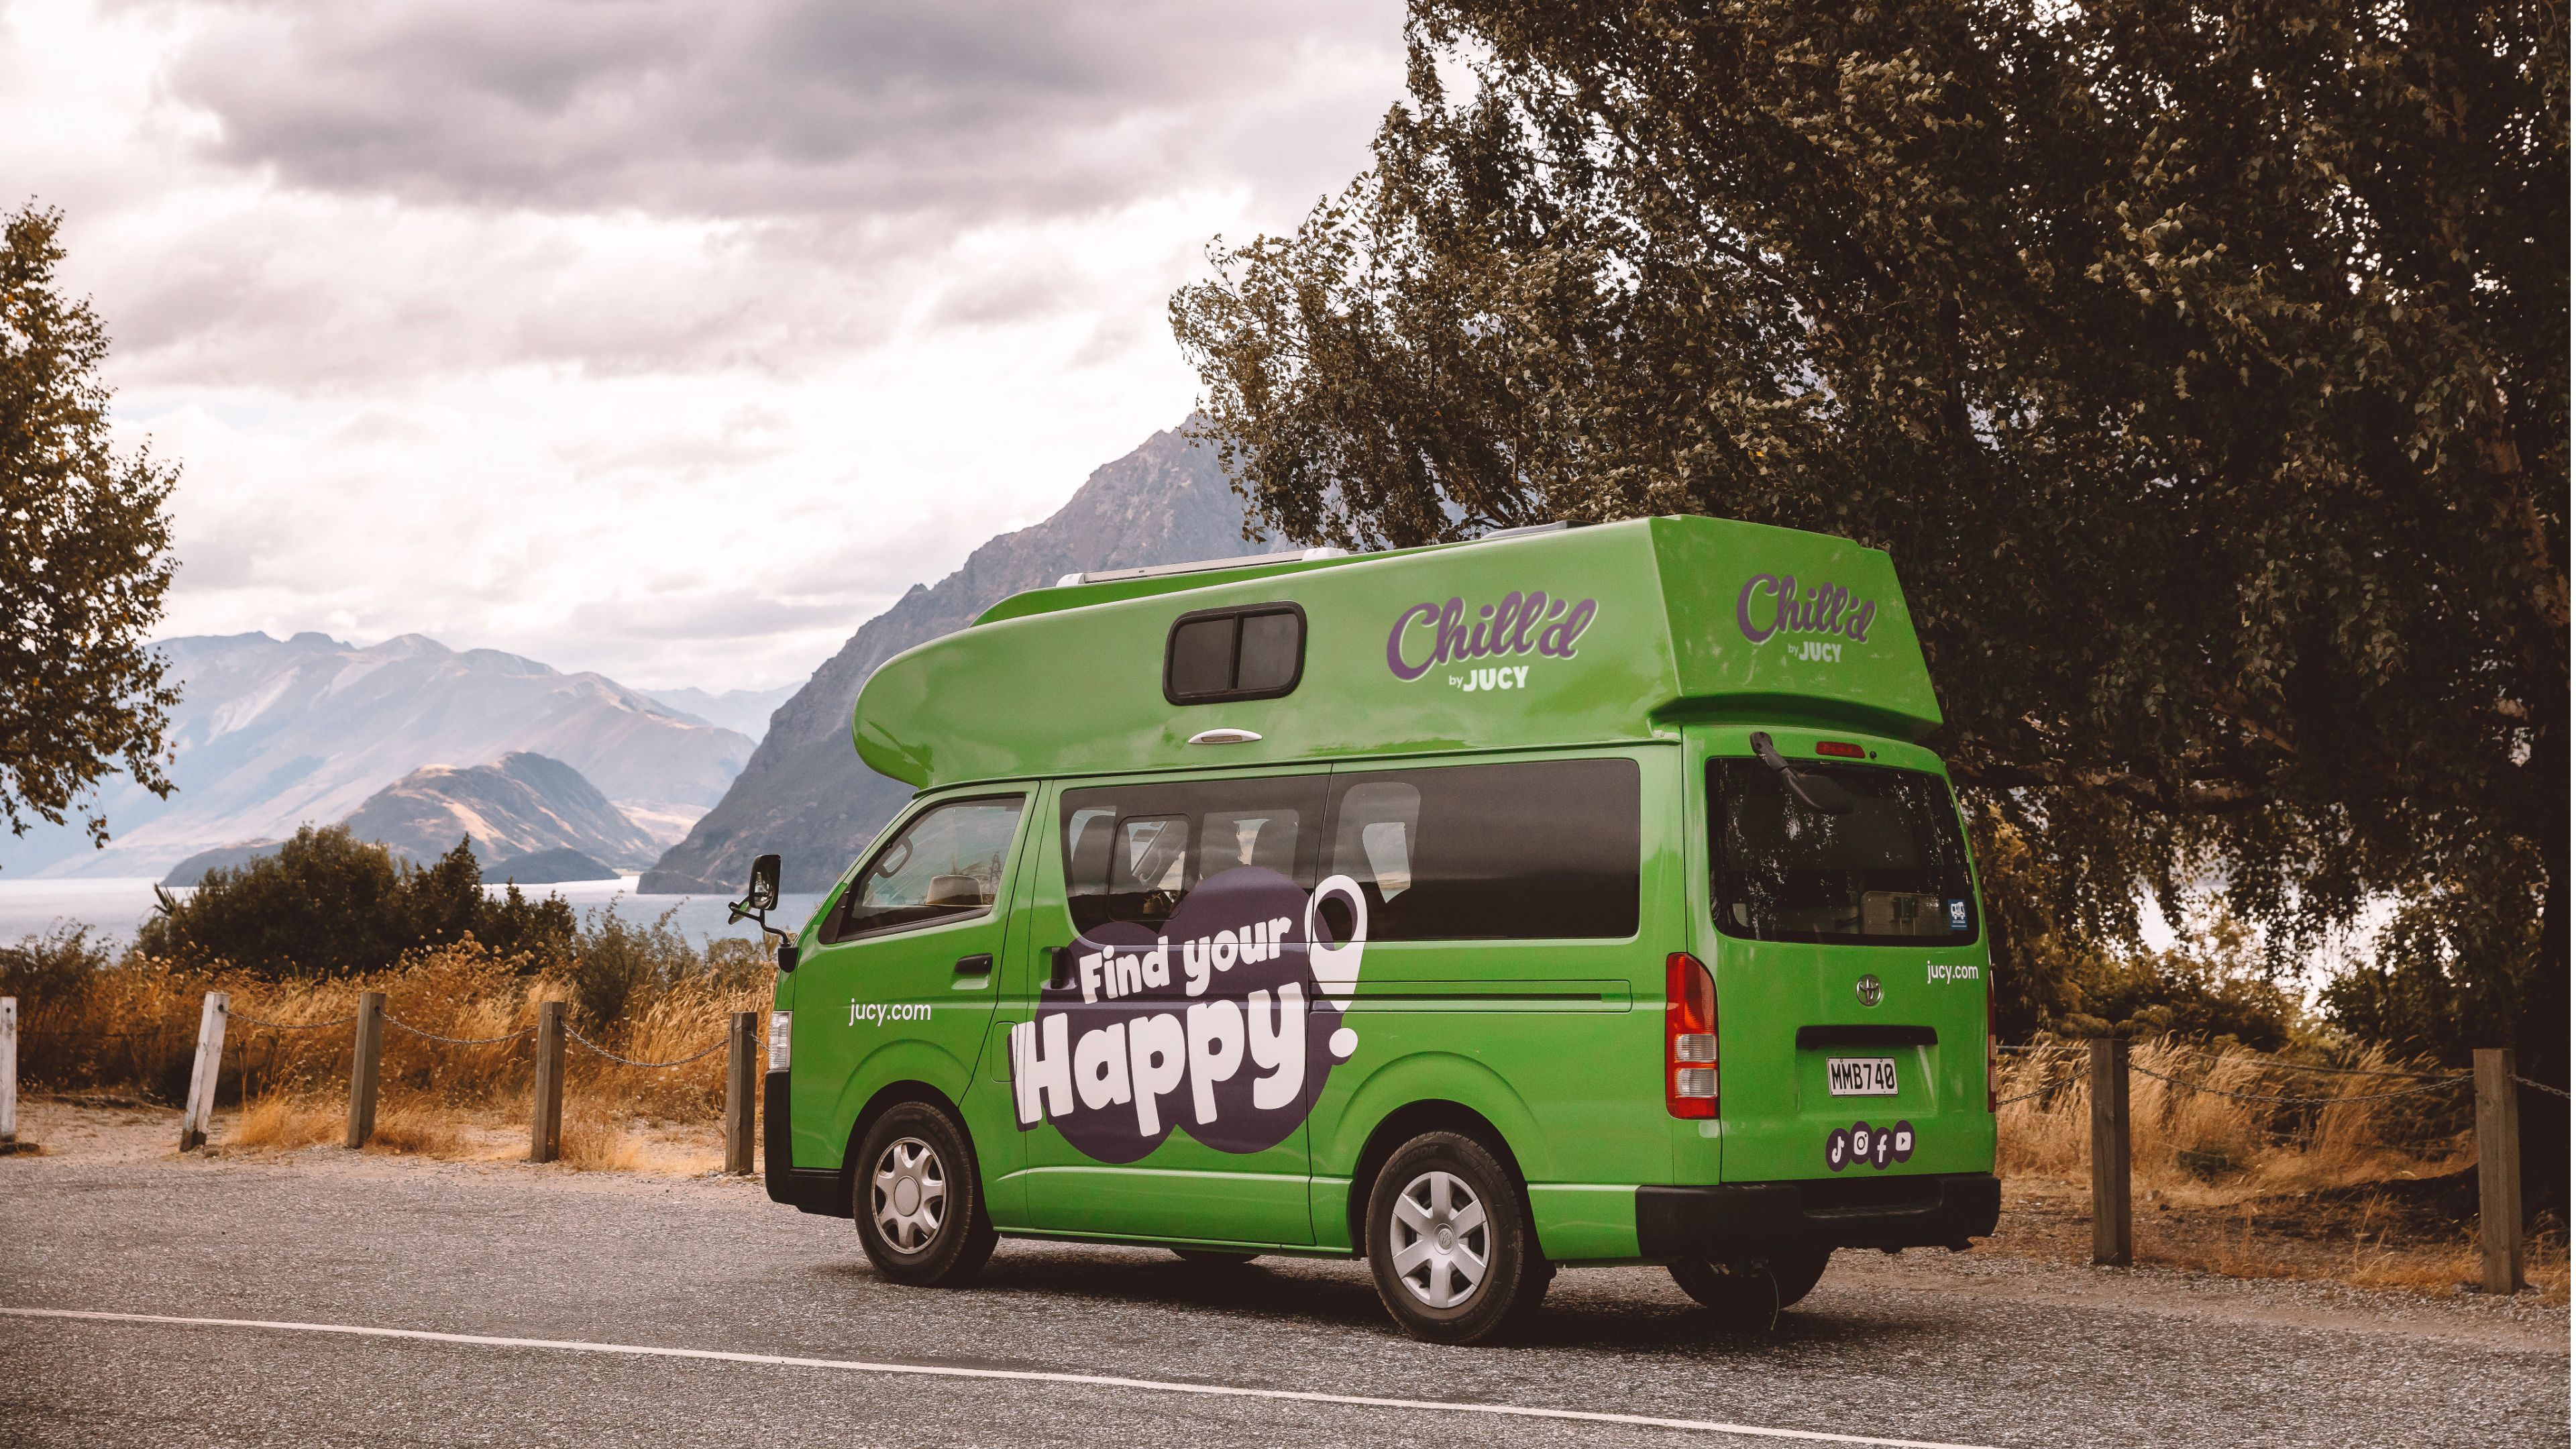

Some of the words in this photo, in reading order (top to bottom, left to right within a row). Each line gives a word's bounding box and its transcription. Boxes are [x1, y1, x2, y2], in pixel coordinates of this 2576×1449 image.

[1737, 573, 1876, 645] Chill'd
[1386, 590, 1598, 682] Chill'd
[1788, 644, 1799, 656] by
[1799, 641, 1841, 663] JUCY
[1448, 675, 1464, 689] by
[1462, 665, 1529, 692] JUCY
[1079, 935, 1171, 1005] Find
[1183, 916, 1292, 997] your
[1927, 960, 1979, 984] jucy.com
[849, 998, 932, 1027] jucy.com
[1831, 1063, 1895, 1090] MMB740
